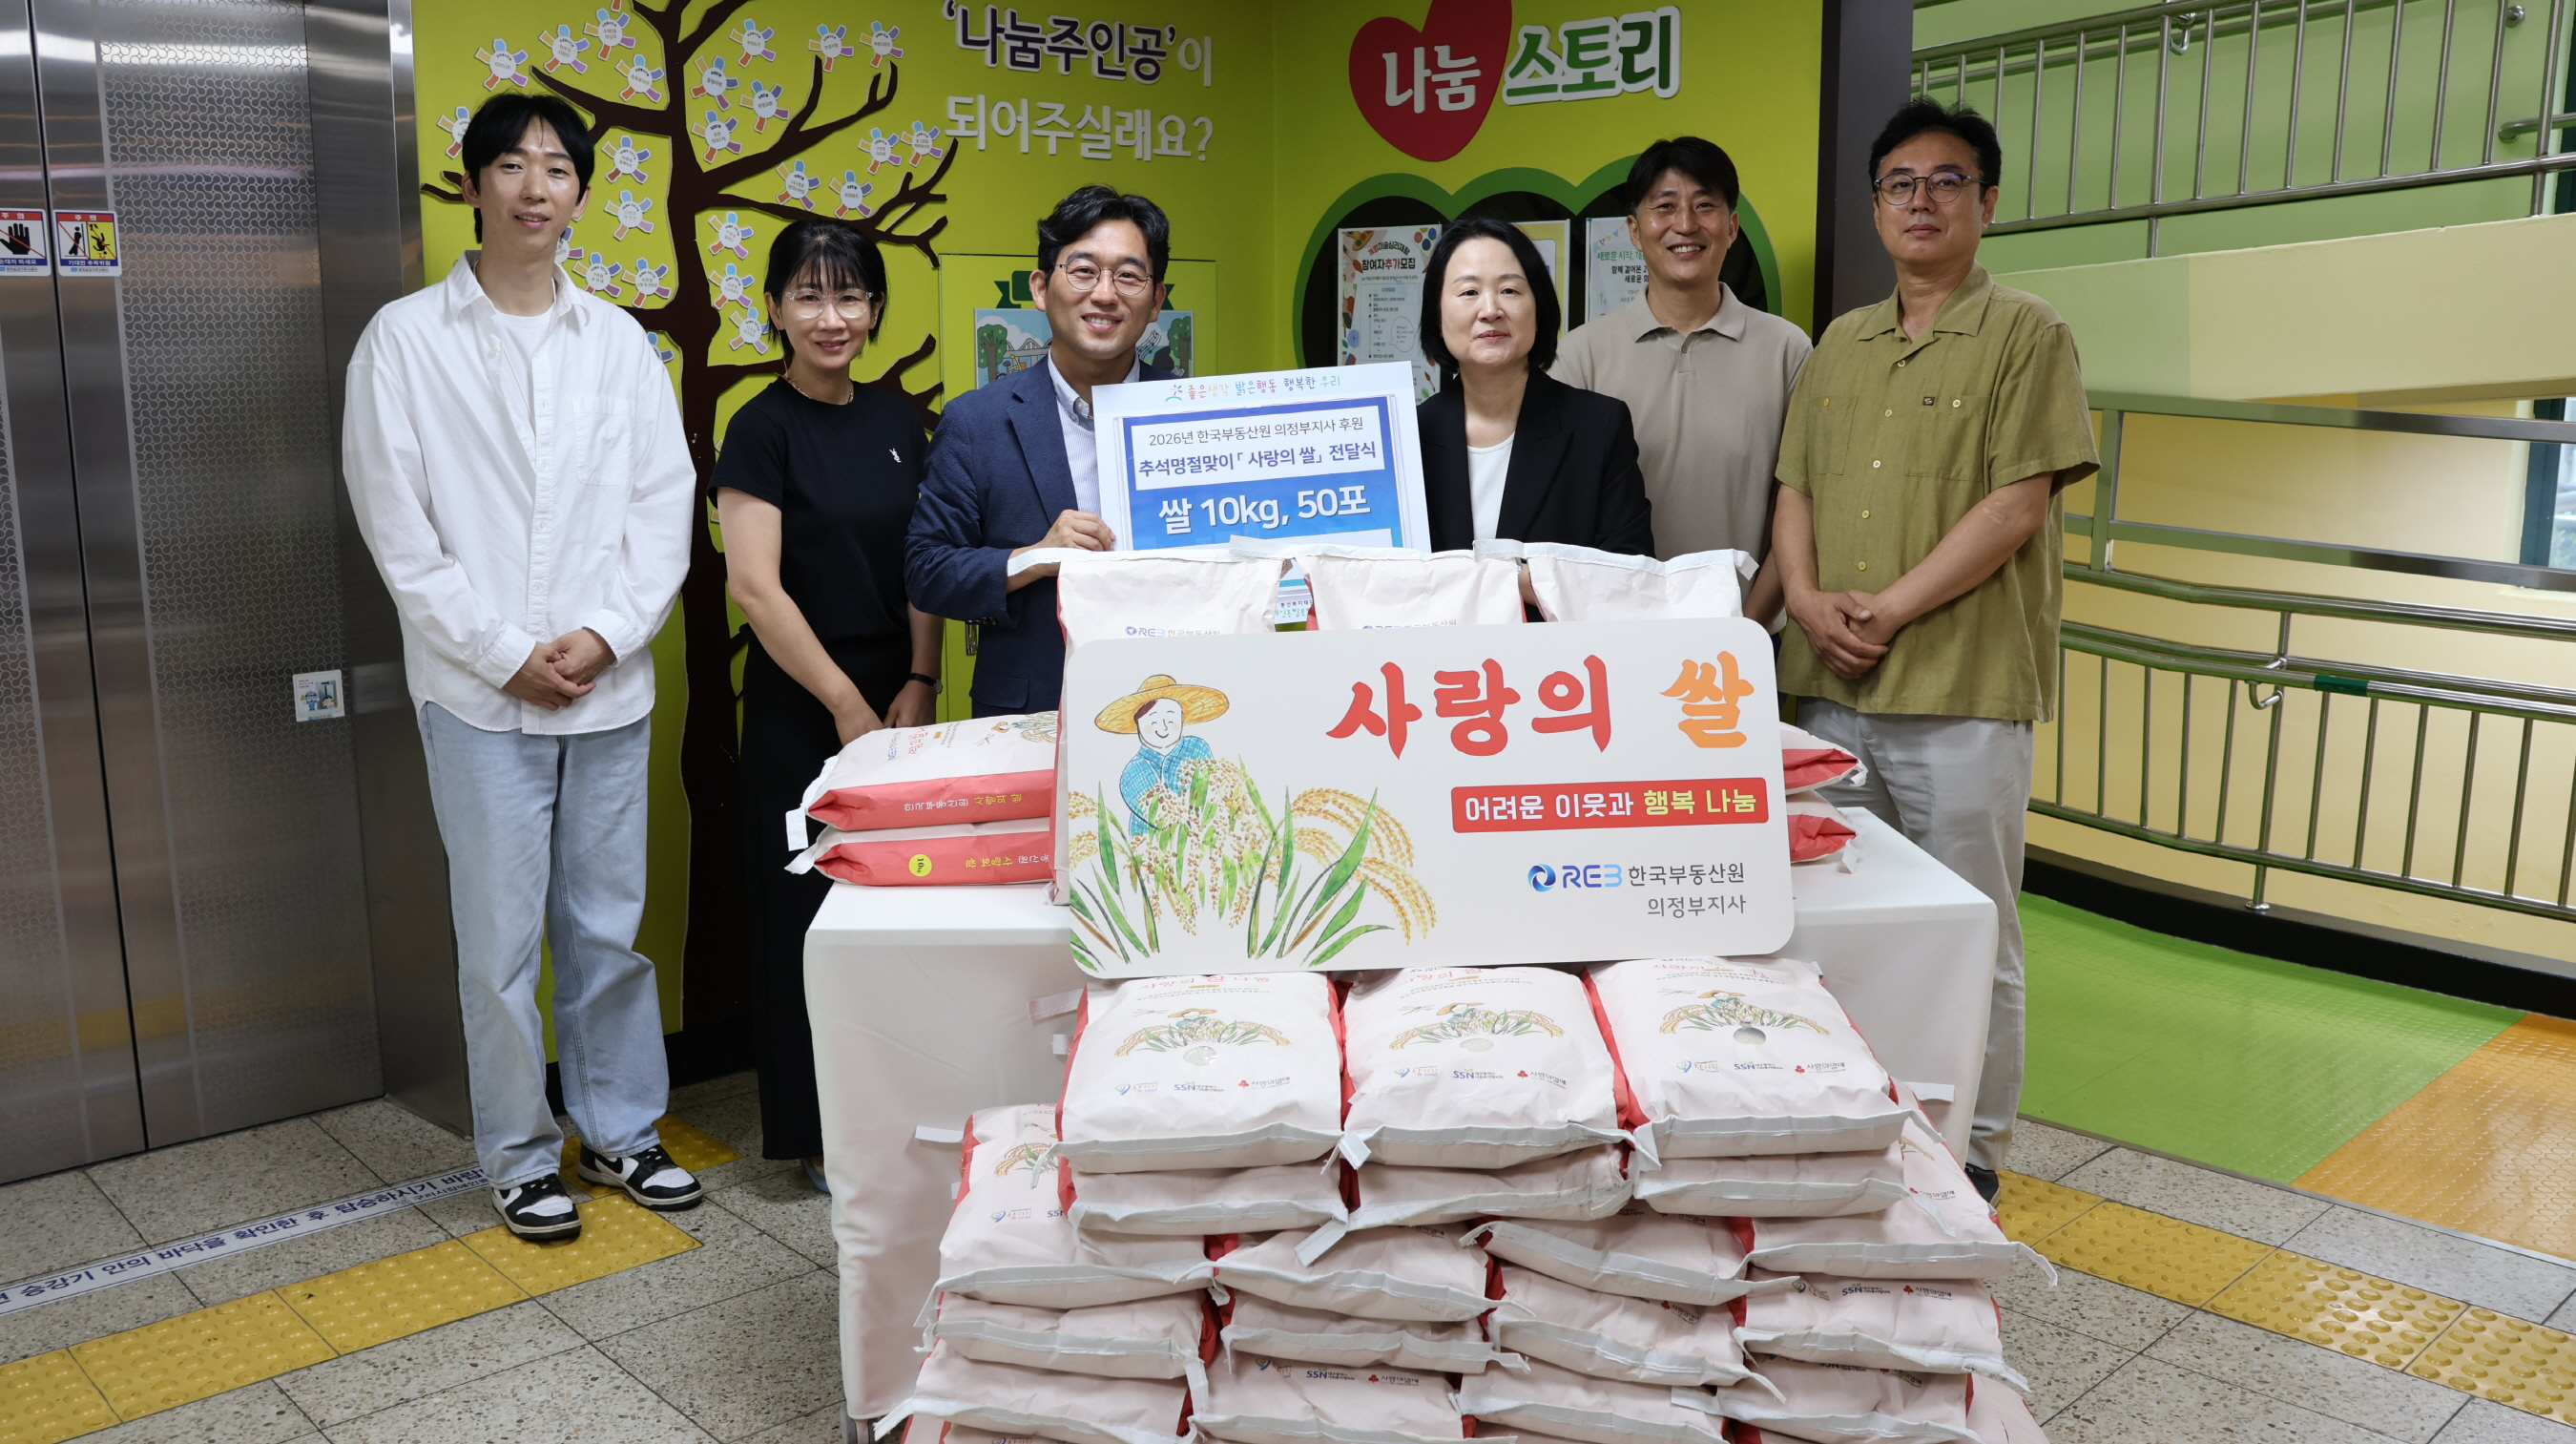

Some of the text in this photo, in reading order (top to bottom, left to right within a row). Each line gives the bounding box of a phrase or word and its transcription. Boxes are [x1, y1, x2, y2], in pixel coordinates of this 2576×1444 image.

[1381, 6, 1682, 115] 나눔 스토리
[945, 94, 1213, 162] 되어주실래요?
[1597, 251, 1617, 262] 새로운
[1618, 250, 1634, 262] 시작,
[1611, 265, 1623, 274] 함께
[1625, 264, 1642, 274] 걸어온
[1625, 275, 1642, 283] 새로운
[1187, 375, 1340, 401] 좋은생각 밝은행동 행복한 우리
[1149, 416, 1363, 446] 2026년 한국부동산원 의정부지사 후원
[1329, 441, 1377, 462] 전달식
[1158, 485, 1371, 535] 쌀 10kg, 50포
[1325, 650, 1755, 761] 사랑의 쌀
[1464, 787, 1757, 822] 어려운 이웃과 행복 나눔
[1018, 853, 1049, 865] 동산원
[1628, 862, 1746, 888] 한국부동산원
[1647, 894, 1747, 919] 의정부지사
[1453, 1070, 1475, 1079] SSN
[20, 1168, 485, 1297] 승강기 안의 바닥을 확인한 후 탑승하시기 바랍
[1841, 1287, 1862, 1297] SSN
[1306, 1371, 1327, 1379] SSN
